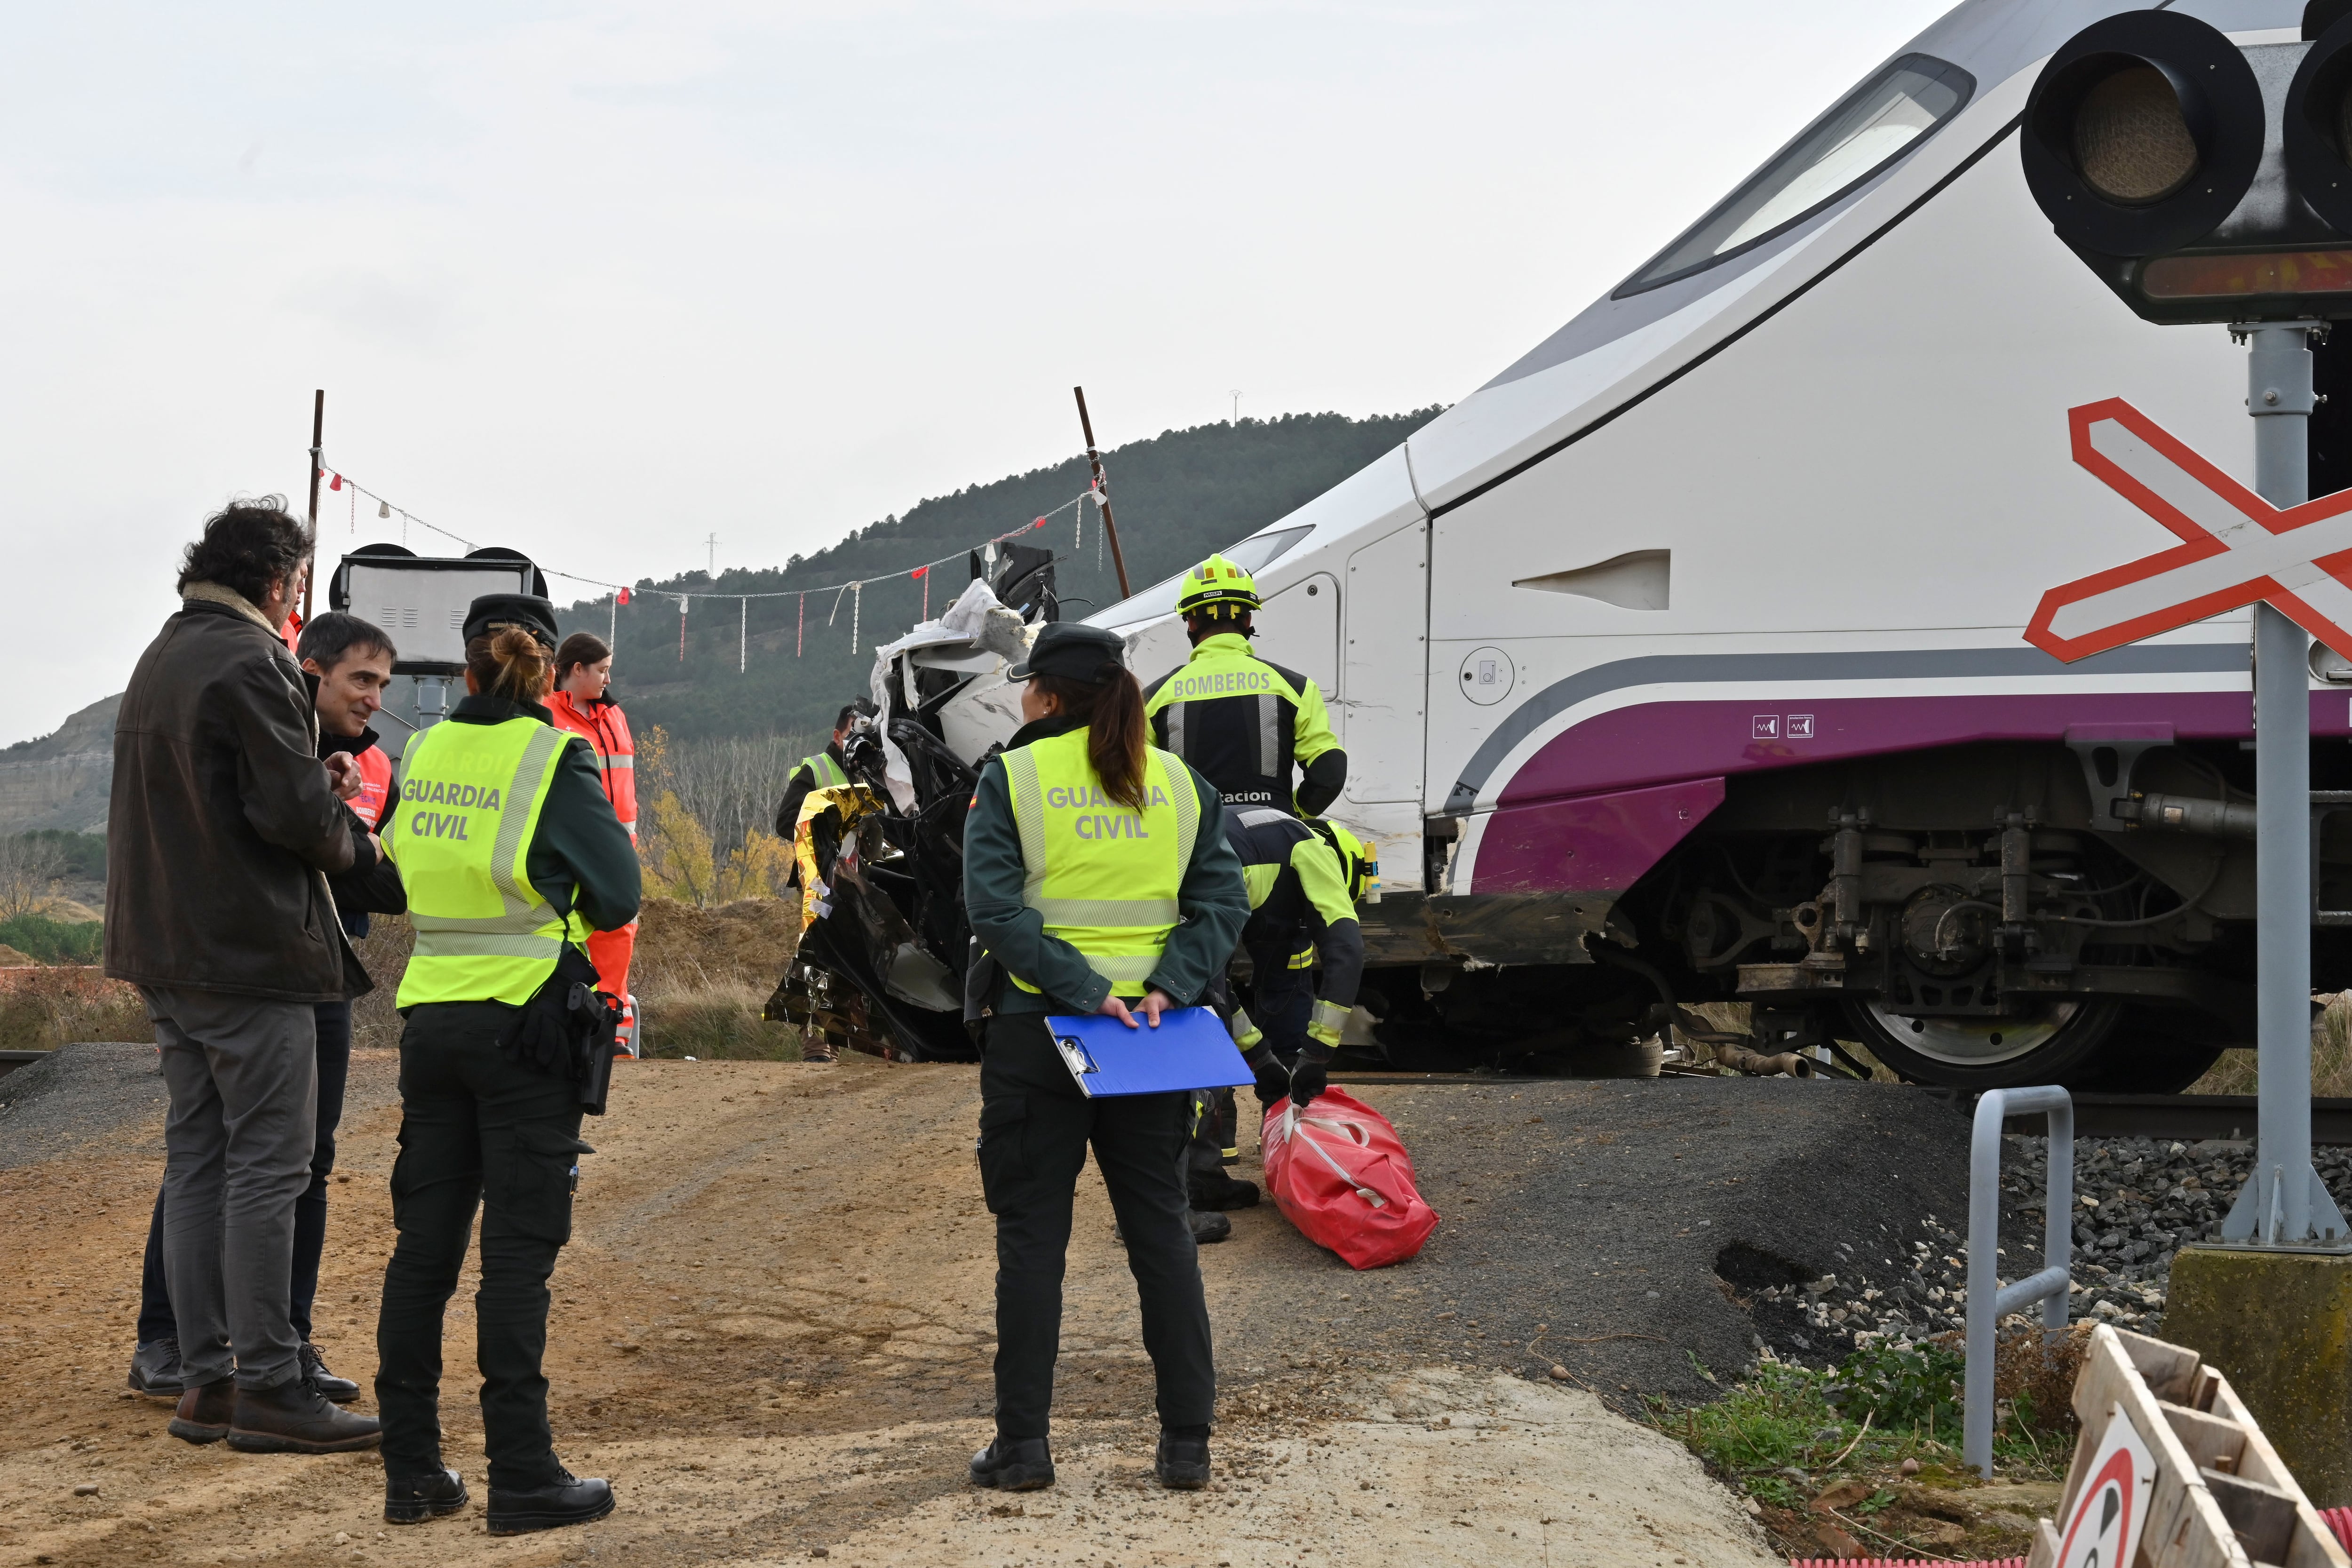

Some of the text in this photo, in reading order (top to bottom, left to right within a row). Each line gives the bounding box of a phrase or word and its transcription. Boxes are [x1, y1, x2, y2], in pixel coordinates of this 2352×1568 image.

[1174, 672, 1270, 697] BOMBEROS
[401, 779, 500, 811] GUARDIA
[1047, 786, 1169, 809] GUAIA
[1219, 790, 1271, 803] tacion
[356, 806, 375, 817] BOMBEROS
[411, 811, 468, 841] CIVIL
[1075, 815, 1149, 839] CIVIL
